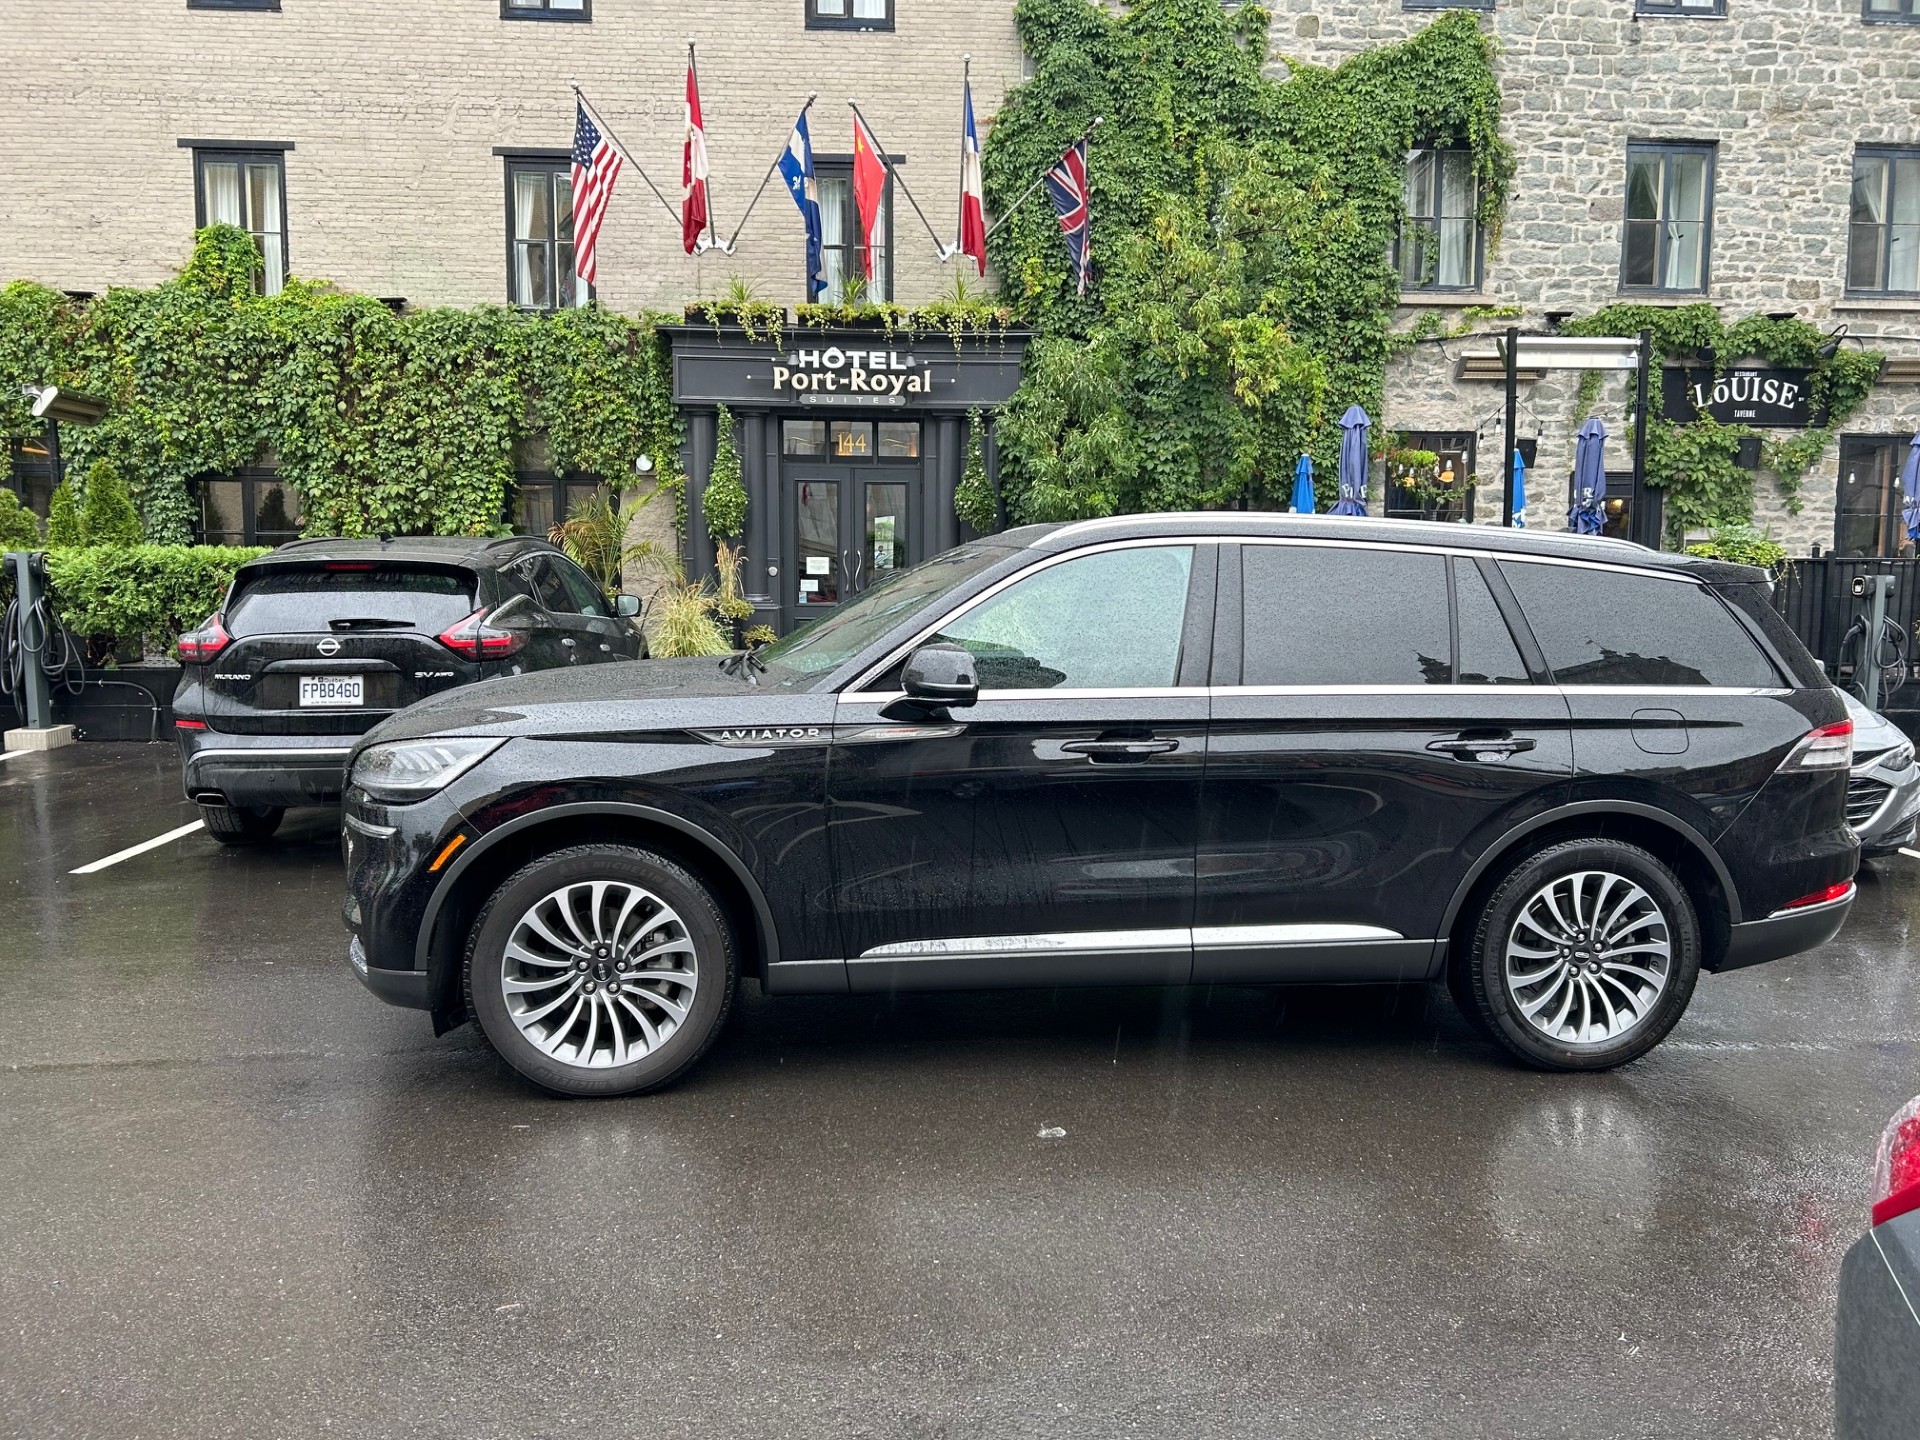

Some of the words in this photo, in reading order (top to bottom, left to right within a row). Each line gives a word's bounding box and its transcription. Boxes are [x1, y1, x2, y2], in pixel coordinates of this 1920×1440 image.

[773, 366, 931, 395] Port-Royal
[809, 396, 896, 404] SUITES
[1734, 409, 1756, 418] TAVERNE
[837, 433, 867, 453] 144
[214, 673, 251, 681] MURANO
[302, 683, 360, 698] FPB8460
[720, 728, 820, 740] AVIATOR
